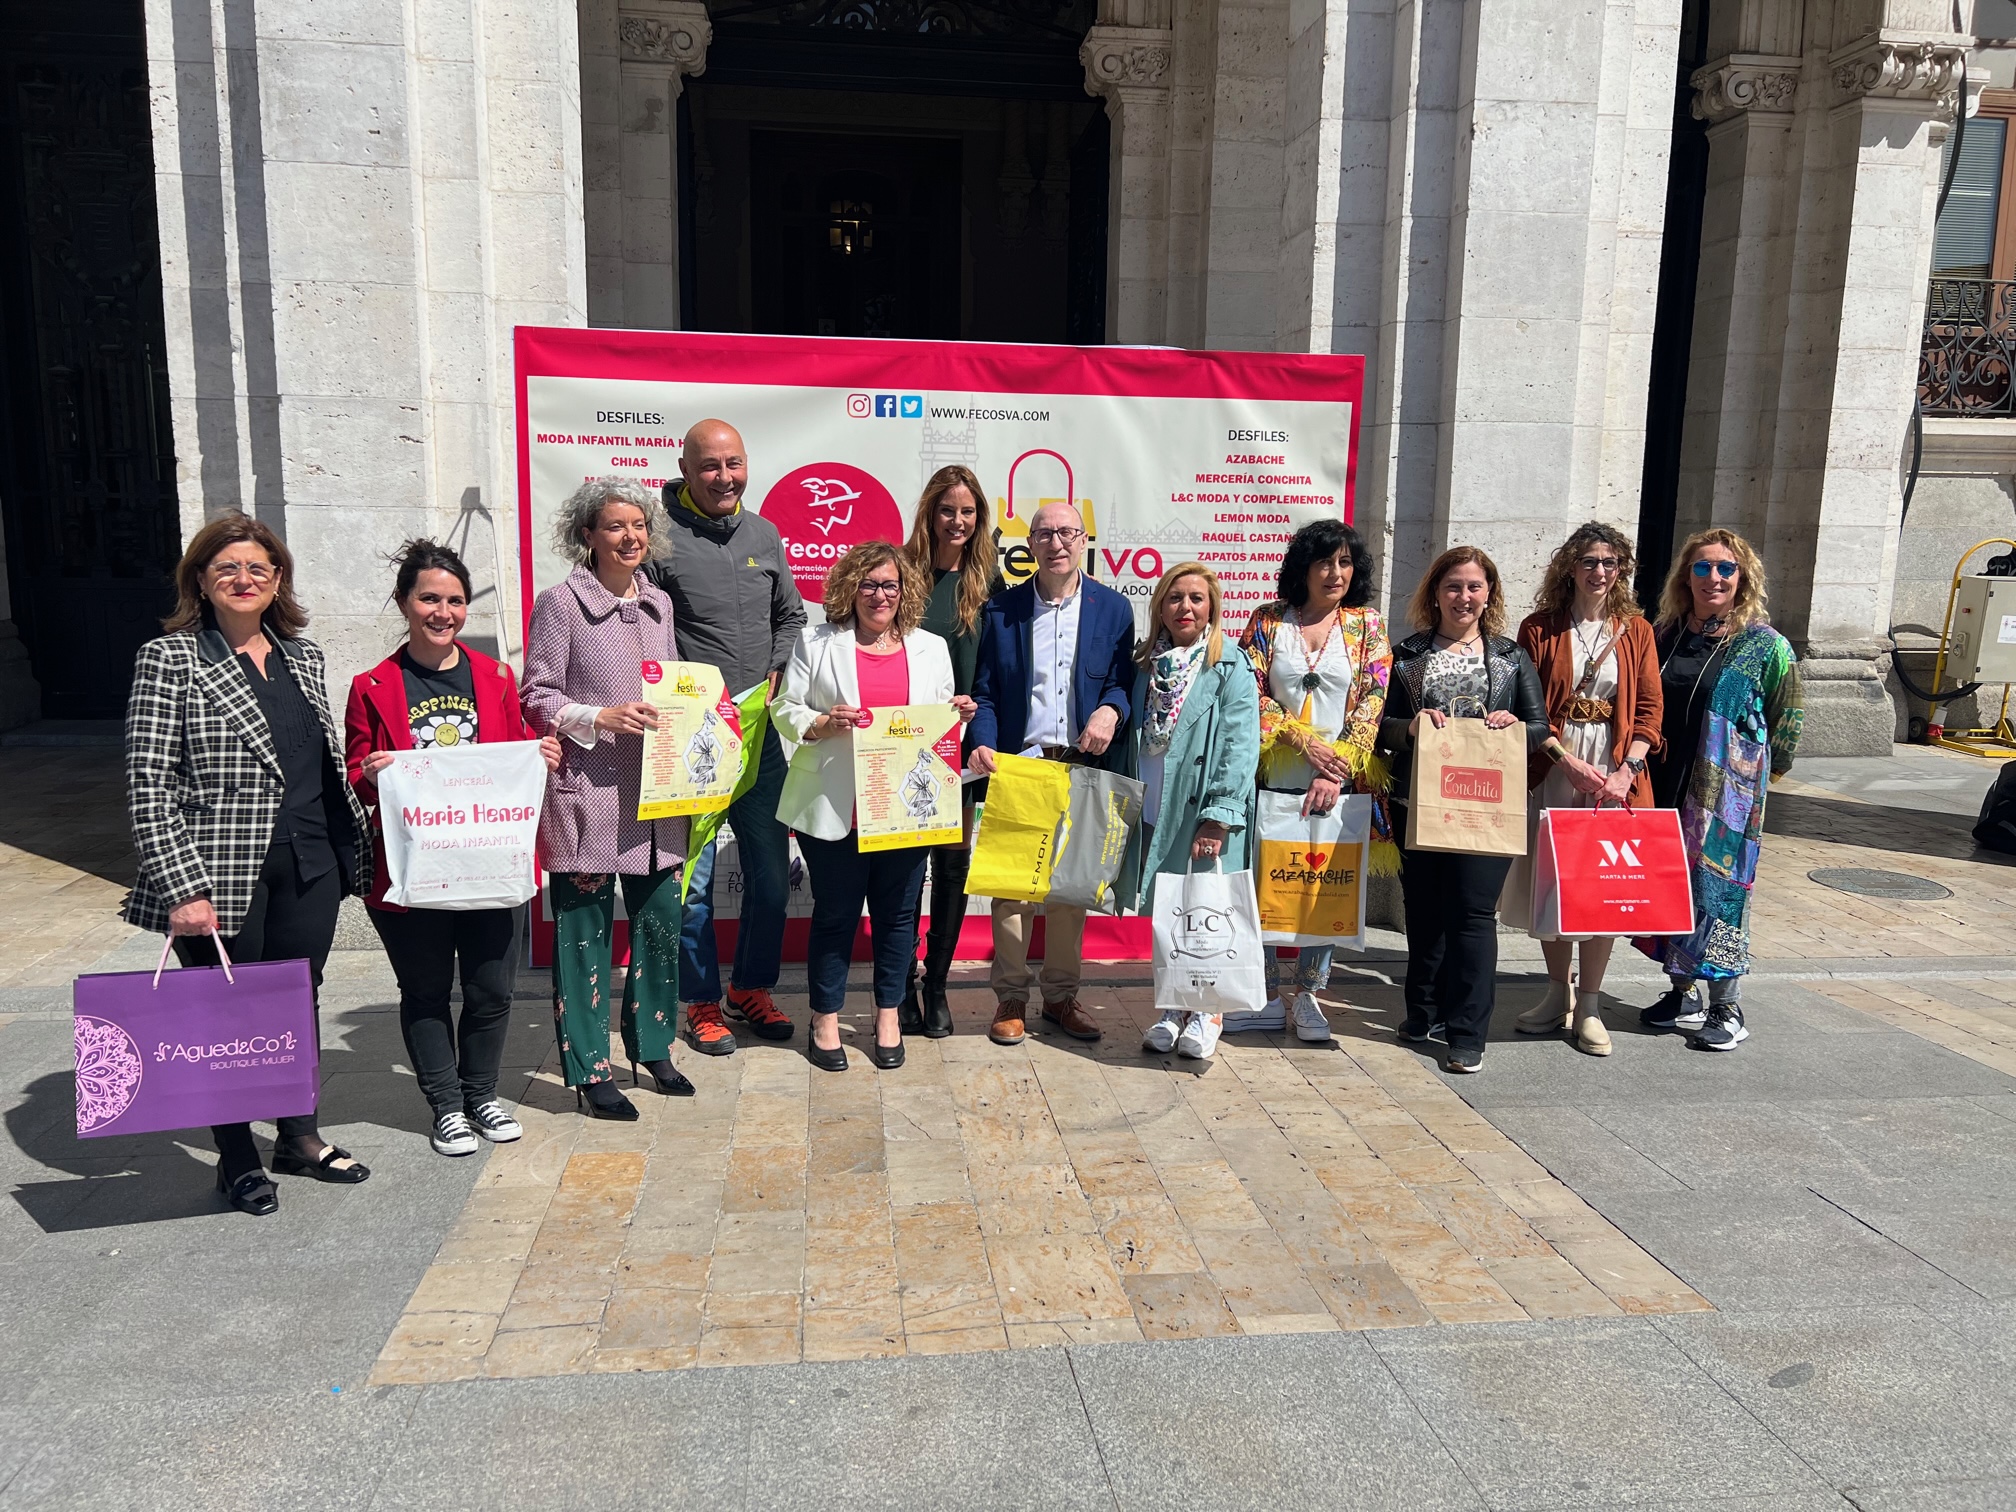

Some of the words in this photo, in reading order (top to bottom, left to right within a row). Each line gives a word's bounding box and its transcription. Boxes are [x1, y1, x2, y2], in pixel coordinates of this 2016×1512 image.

[596, 411, 665, 425] DESFILES:
[931, 407, 1050, 422] WWW.FECOSVA.COM
[537, 433, 574, 444] MODA
[577, 435, 632, 446] INFANTIL
[635, 435, 675, 448] MARÍA
[1228, 429, 1289, 442] DESFILES:
[611, 457, 649, 467] CHIAS
[1225, 454, 1285, 465] AZABACHE
[1195, 472, 1254, 484] MERCERÍA
[1257, 474, 1312, 485] CONCHITA
[1171, 493, 1194, 502] L&C
[1196, 493, 1230, 503] MODA
[1233, 494, 1241, 503] Y
[1243, 494, 1334, 505] COMPLEMENTOS
[1214, 513, 1253, 523] LEMON
[1256, 514, 1290, 524] MODA
[1202, 532, 1247, 543] RAQUEL
[1197, 552, 1247, 562] ZAPATOS
[1261, 572, 1271, 581] &
[677, 682, 707, 693] festiva
[889, 725, 924, 735] festiva
[443, 775, 494, 787] LENCERÍA
[1444, 773, 1499, 799] Conchita
[403, 805, 466, 827] Maria
[473, 803, 535, 824] Henar
[421, 839, 460, 850] MODA
[463, 835, 521, 848] INFANTIL
[1029, 833, 1049, 895] LEMON
[1288, 851, 1304, 867] I
[171, 1036, 280, 1063] Agued&Co
[210, 1059, 259, 1070] BOUTIQUE
[262, 1055, 295, 1066] MUJER
